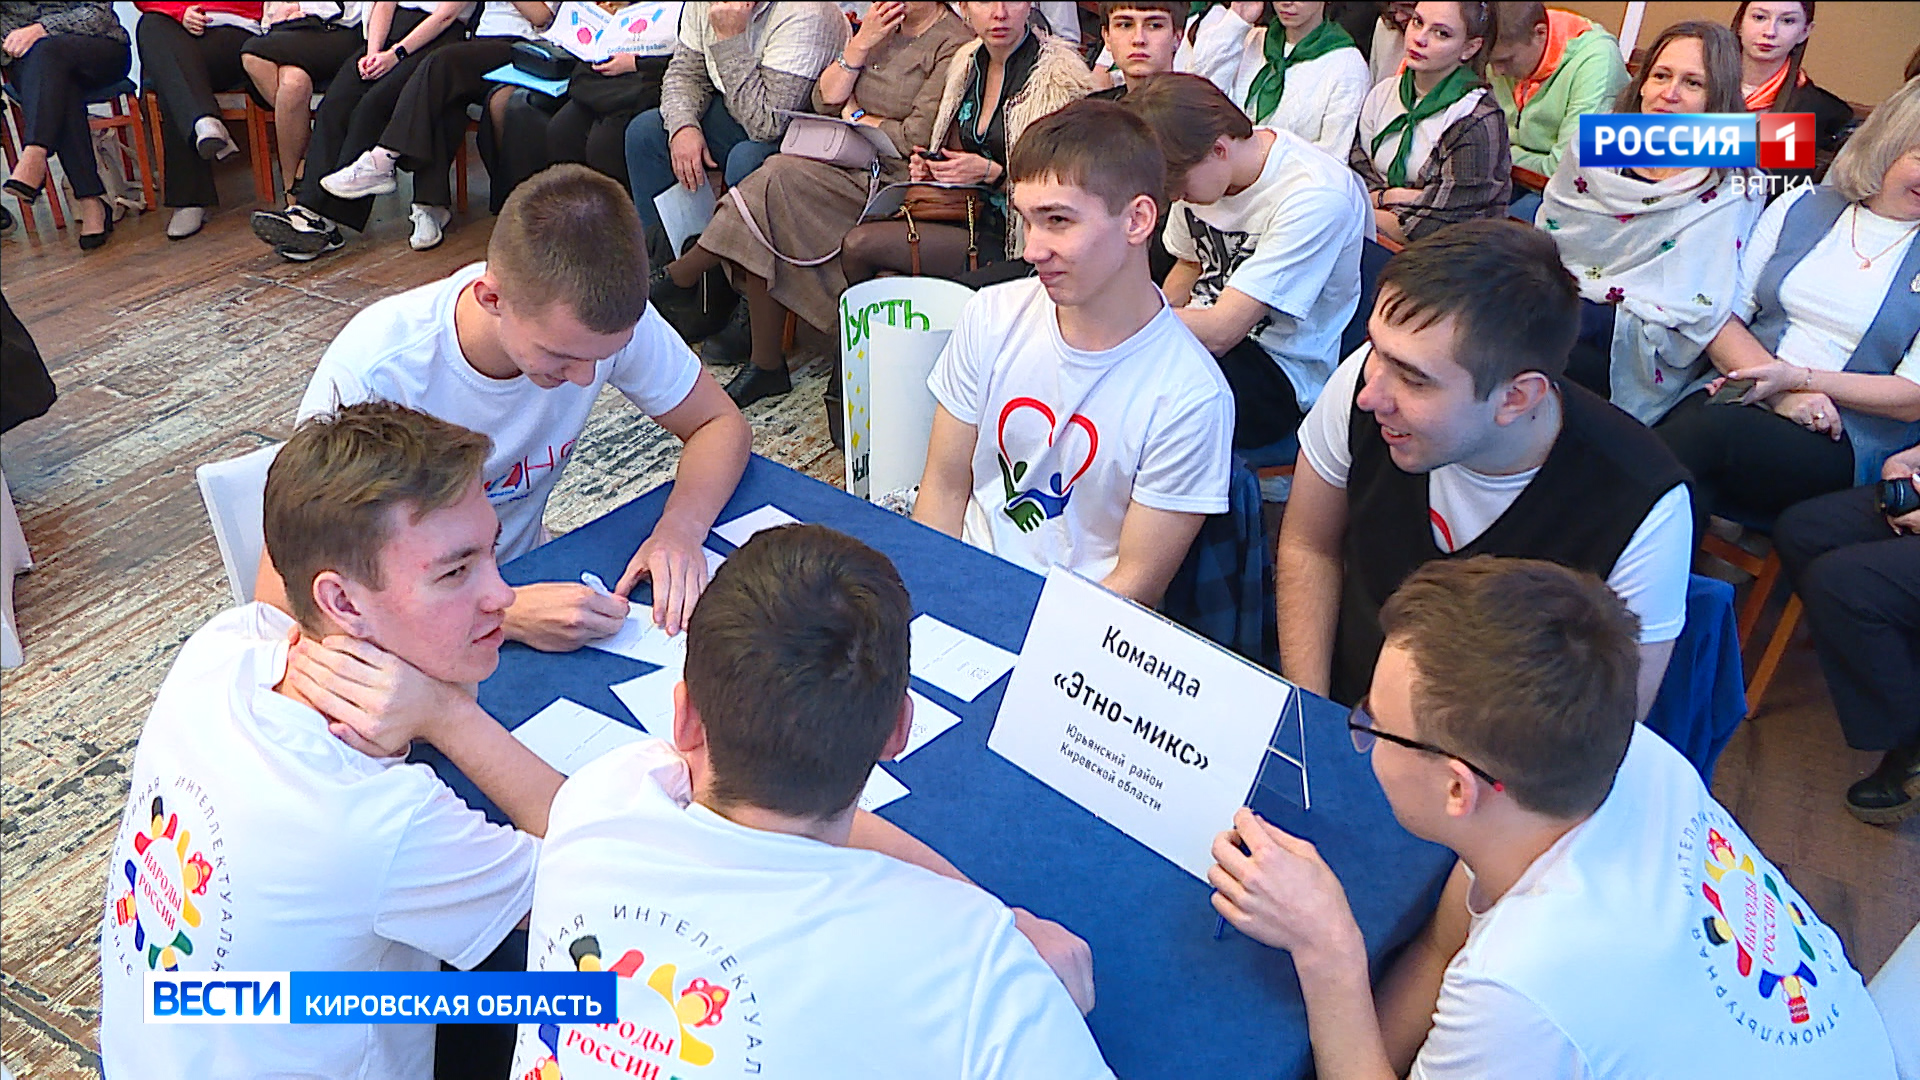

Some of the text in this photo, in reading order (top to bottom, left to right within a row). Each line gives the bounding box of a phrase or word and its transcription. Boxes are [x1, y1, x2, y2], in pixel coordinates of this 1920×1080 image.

[1102, 625, 1201, 699] Команда
[1054, 671, 1209, 771] «Этно-микс»
[1066, 723, 1164, 790] Юрьянский район
[1060, 741, 1162, 812] Кировской области
[138, 873, 176, 932] РОССИИ
[143, 851, 182, 912] НАРОДЫ
[174, 775, 233, 972] ИНТЕЛЛЕКТУАЛЬН
[613, 904, 763, 1075] ИНТЕЛЛЕКТУАЛ
[565, 1029, 661, 1080] РОССИИ
